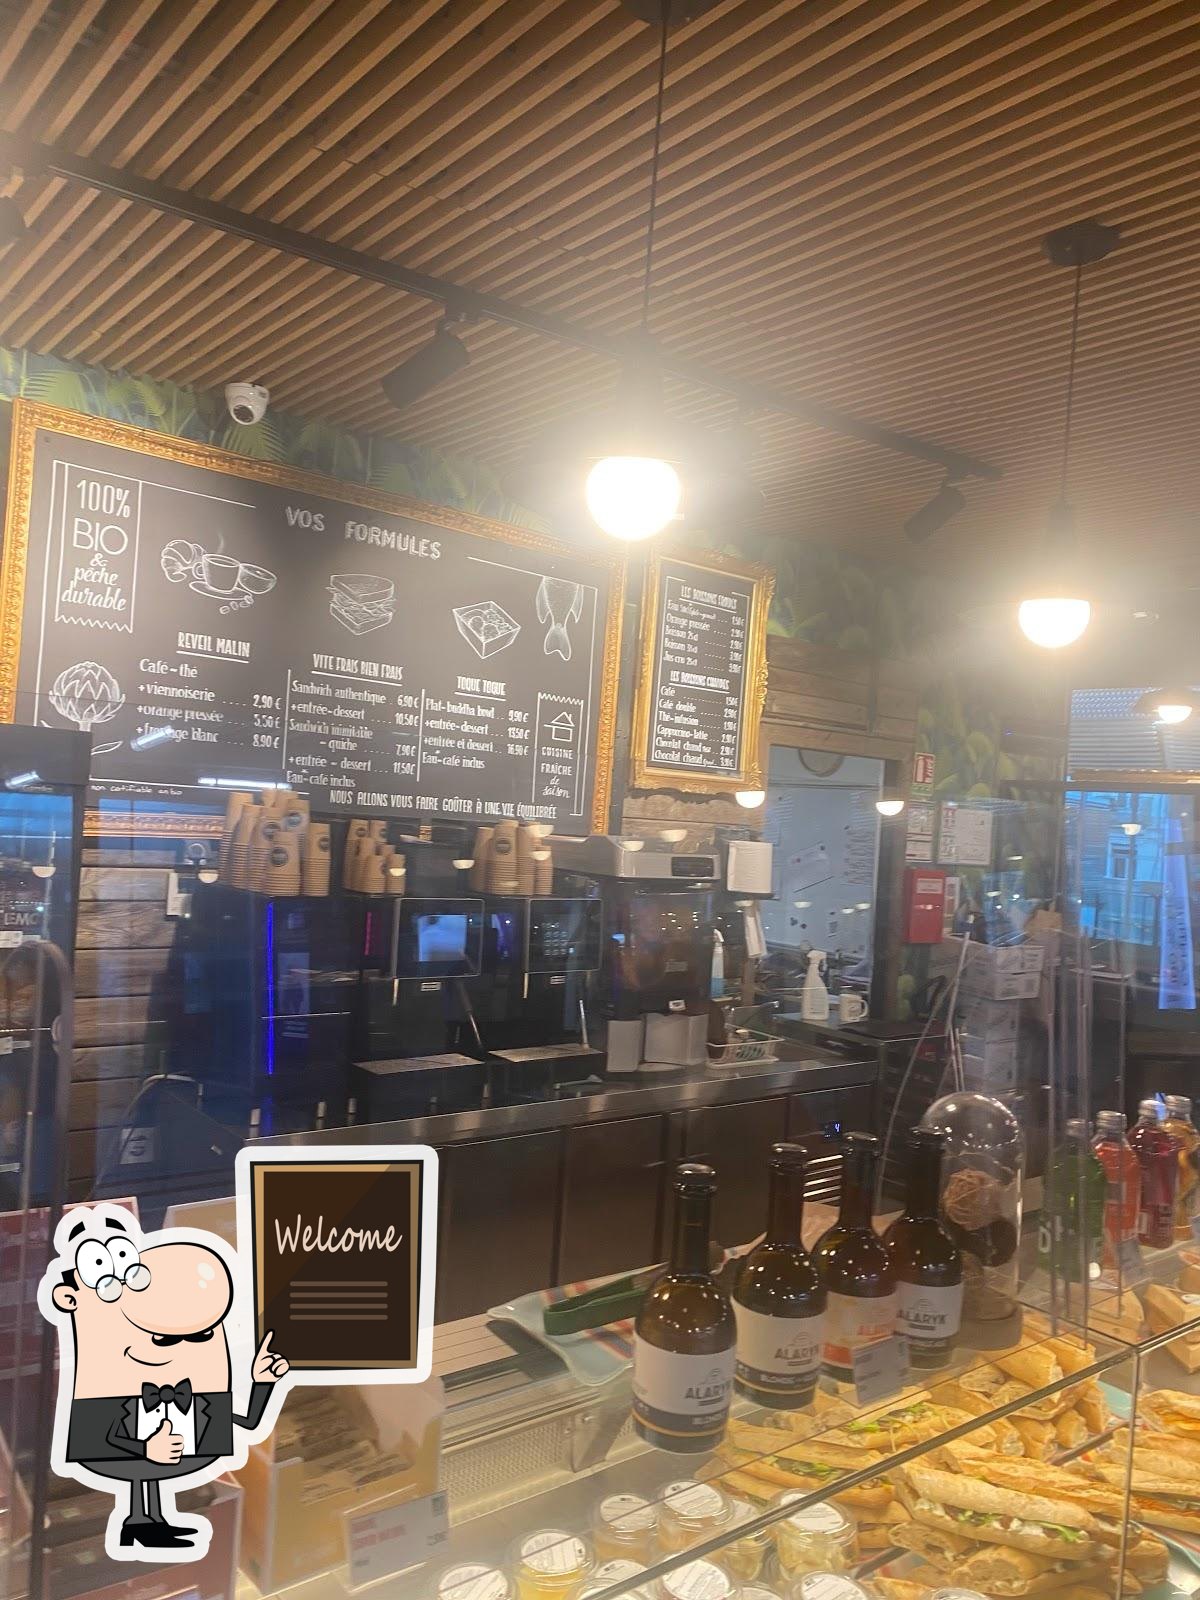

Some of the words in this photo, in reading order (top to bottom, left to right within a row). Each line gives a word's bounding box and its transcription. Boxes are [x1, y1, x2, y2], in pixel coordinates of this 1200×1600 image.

[77, 479, 130, 518] 100%
[73, 518, 128, 555] BIO
[285, 506, 325, 532] VOS
[344, 520, 442, 560] FORMULES
[90, 553, 108, 567] &
[74, 566, 118, 588] pêche
[62, 581, 126, 611] durable
[178, 632, 212, 651] REVEIL
[216, 638, 250, 657] MALIN
[313, 653, 334, 670] VITE
[336, 657, 358, 674] FRAIS
[360, 660, 379, 677] BIEN
[381, 663, 404, 680] FRAIS
[457, 675, 481, 692] TOQUE
[482, 679, 506, 695] TOQUE
[660, 685, 676, 696] Café
[291, 680, 332, 697] Sandwich
[335, 686, 386, 706] authentique
[659, 698, 674, 709] Café
[676, 701, 696, 712] double
[184, 710, 224, 722] pressée
[477, 706, 495, 719] bowl
[289, 718, 329, 735] Sandwich
[191, 727, 219, 742] blanc
[328, 738, 357, 752] quiche
[456, 740, 465, 750] et
[467, 739, 493, 752] dessert
[655, 736, 681, 749] Chocolat
[541, 746, 573, 760] CUISINE
[654, 750, 680, 761] Chocolat
[340, 757, 371, 772] dessert
[463, 756, 485, 769] inclus
[330, 775, 356, 788] inclus
[550, 776, 559, 785] de
[542, 785, 571, 798] saison
[329, 789, 353, 804] NOUS
[357, 791, 388, 807] ALLONS
[390, 794, 413, 809] VOUS
[415, 796, 439, 811] FAIRE
[442, 797, 473, 814] GOÛTER
[476, 798, 482, 814] À
[484, 801, 501, 816] UNE
[501, 803, 515, 817] VIE
[516, 802, 558, 819] ÉQUILIBRÉE
